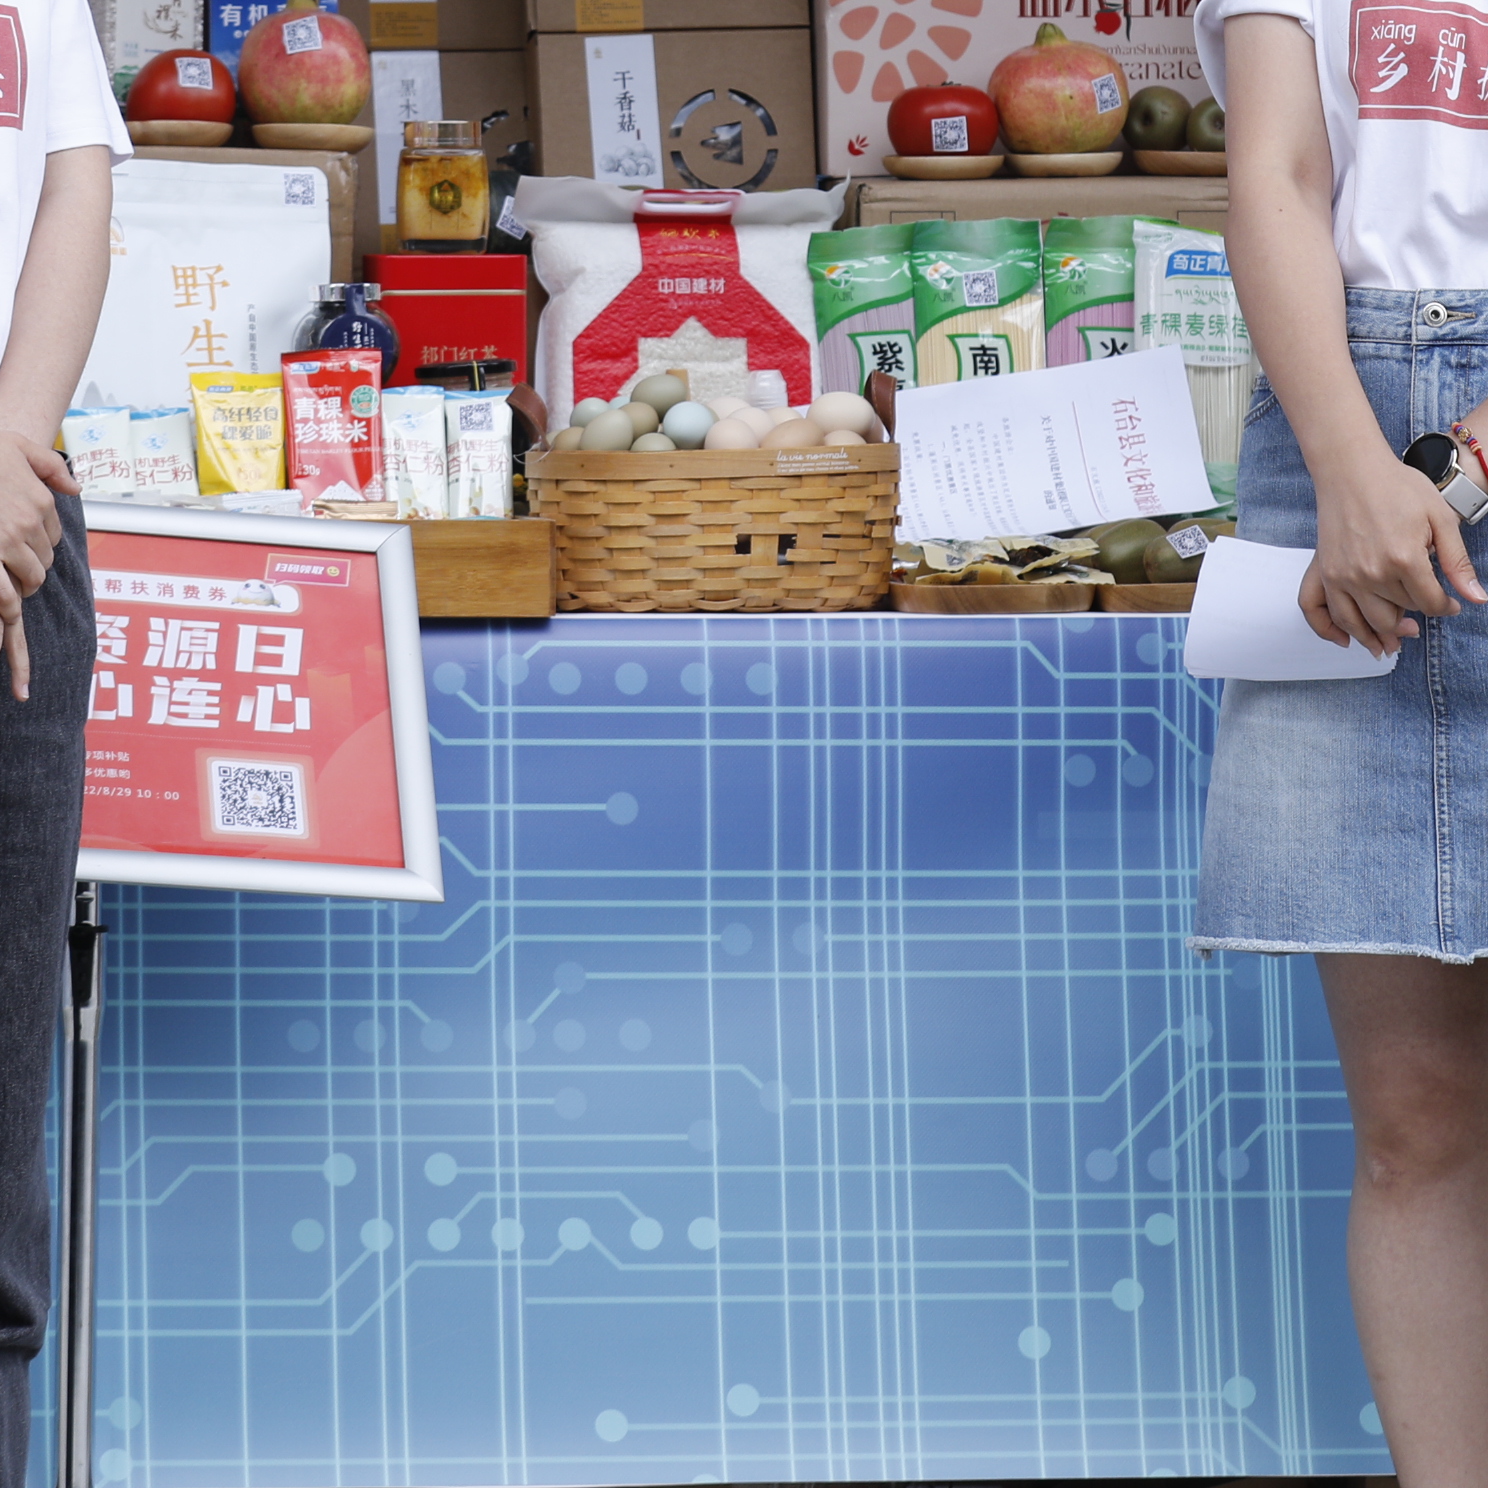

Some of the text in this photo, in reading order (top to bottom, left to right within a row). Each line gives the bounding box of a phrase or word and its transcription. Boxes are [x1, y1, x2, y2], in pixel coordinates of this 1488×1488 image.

[1370, 20, 1416, 45] xiāng
[1438, 27, 1466, 50] cūn
[398, 78, 419, 138] 黑木
[612, 70, 638, 134] 干香菇
[658, 277, 726, 294] 中国建材
[171, 263, 235, 404] 野生
[213, 406, 280, 423] 高纤轻食
[294, 396, 344, 420] 青稞
[294, 420, 369, 444] 珍珠米
[275, 562, 325, 575] 扫码领取
